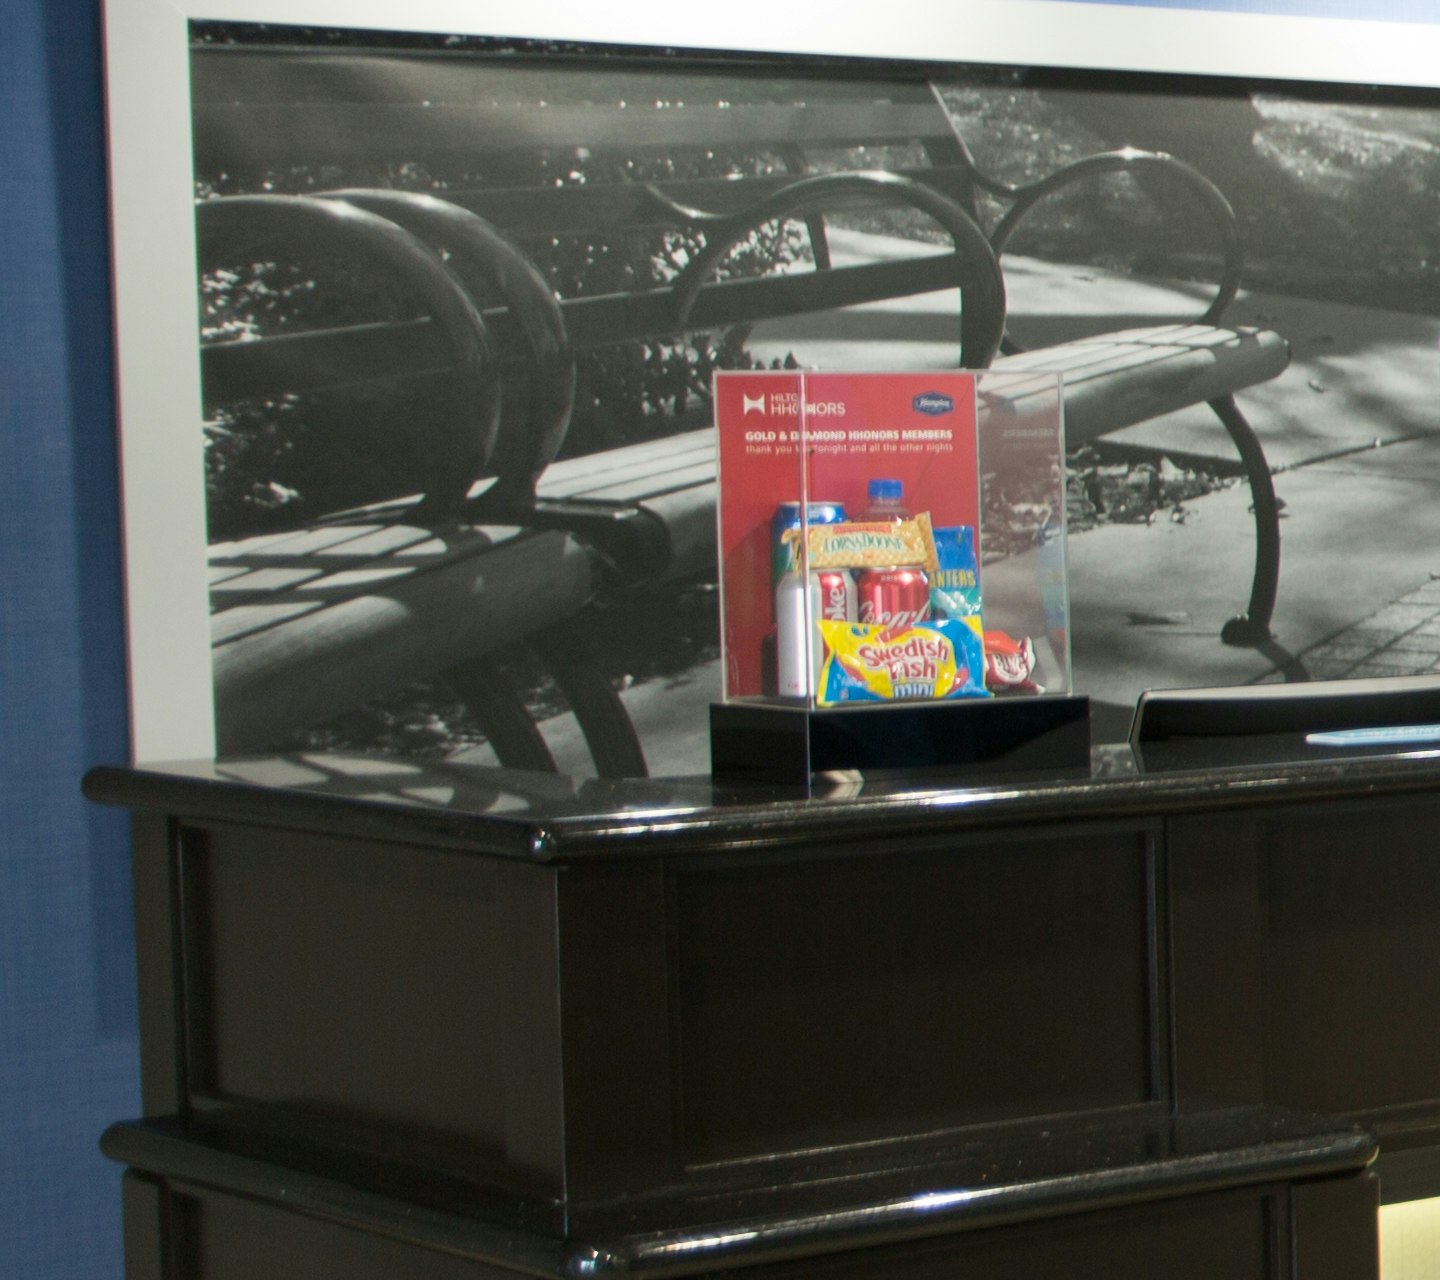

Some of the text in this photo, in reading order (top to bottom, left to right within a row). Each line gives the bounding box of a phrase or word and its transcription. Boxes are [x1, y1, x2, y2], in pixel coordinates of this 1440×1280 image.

[771, 392, 800, 403] HILTO
[745, 431, 776, 441] GOLD
[848, 430, 899, 441] HHONORS
[902, 429, 953, 440] MEMBERS
[745, 444, 772, 454] thank
[776, 446, 792, 455] you
[850, 443, 866, 453] and
[869, 443, 880, 453] all
[883, 442, 897, 453] the
[899, 442, 923, 453] other
[858, 638, 949, 666] Swedish
[887, 658, 937, 681] Fish
[893, 683, 935, 698] mini
